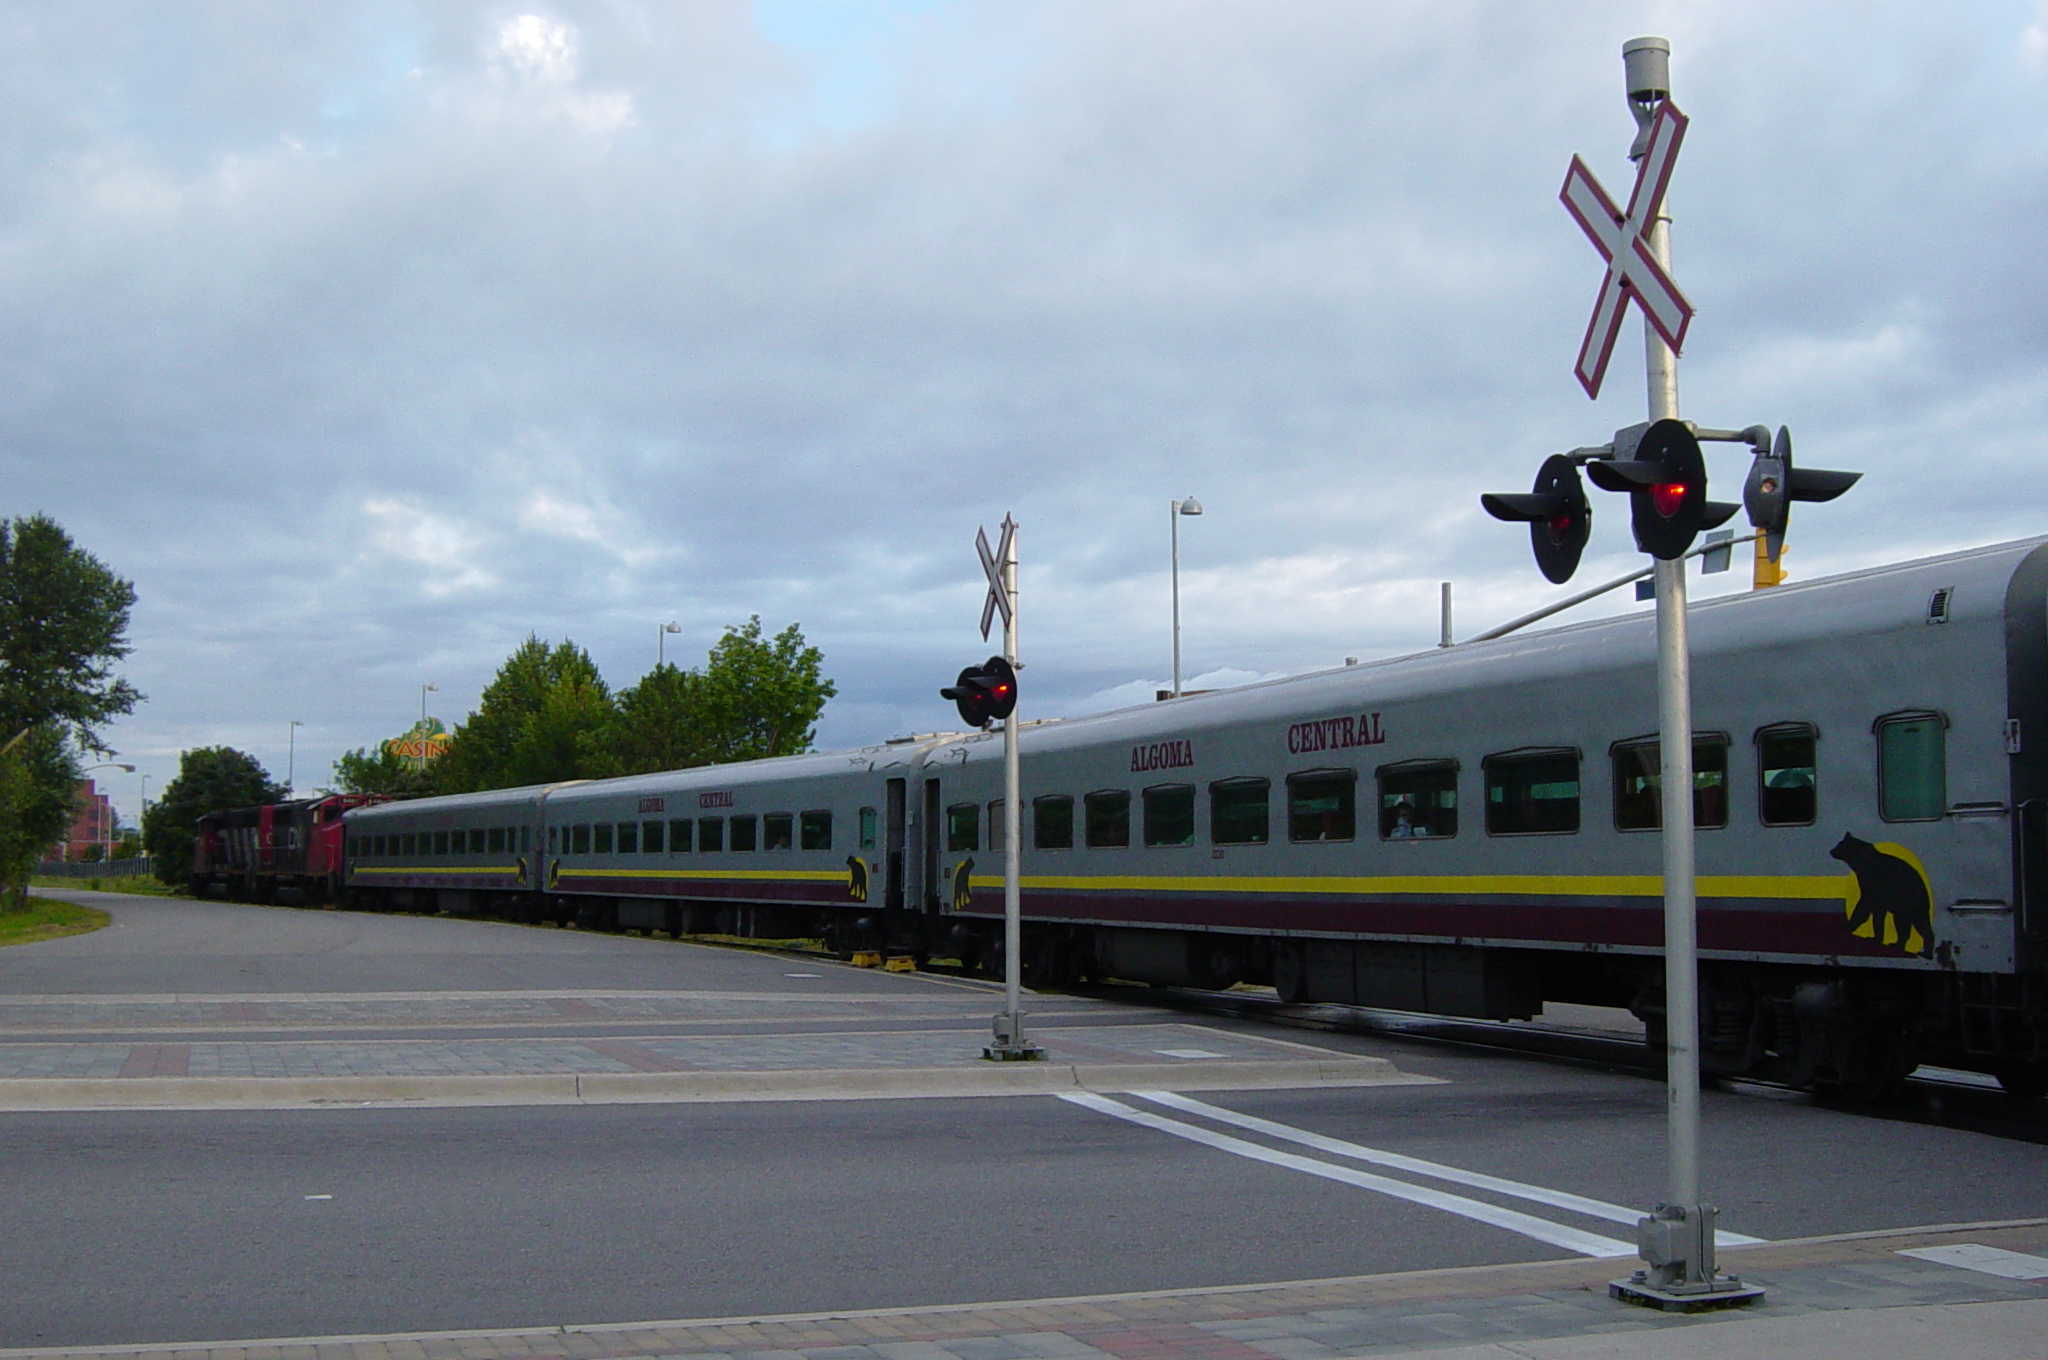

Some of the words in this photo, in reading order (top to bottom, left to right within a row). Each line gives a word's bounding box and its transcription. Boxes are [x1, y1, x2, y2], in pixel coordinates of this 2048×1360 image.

[385, 739, 454, 758] CASIN
[1130, 740, 1193, 772] ALGOMA
[1287, 713, 1385, 754] CENTRAL
